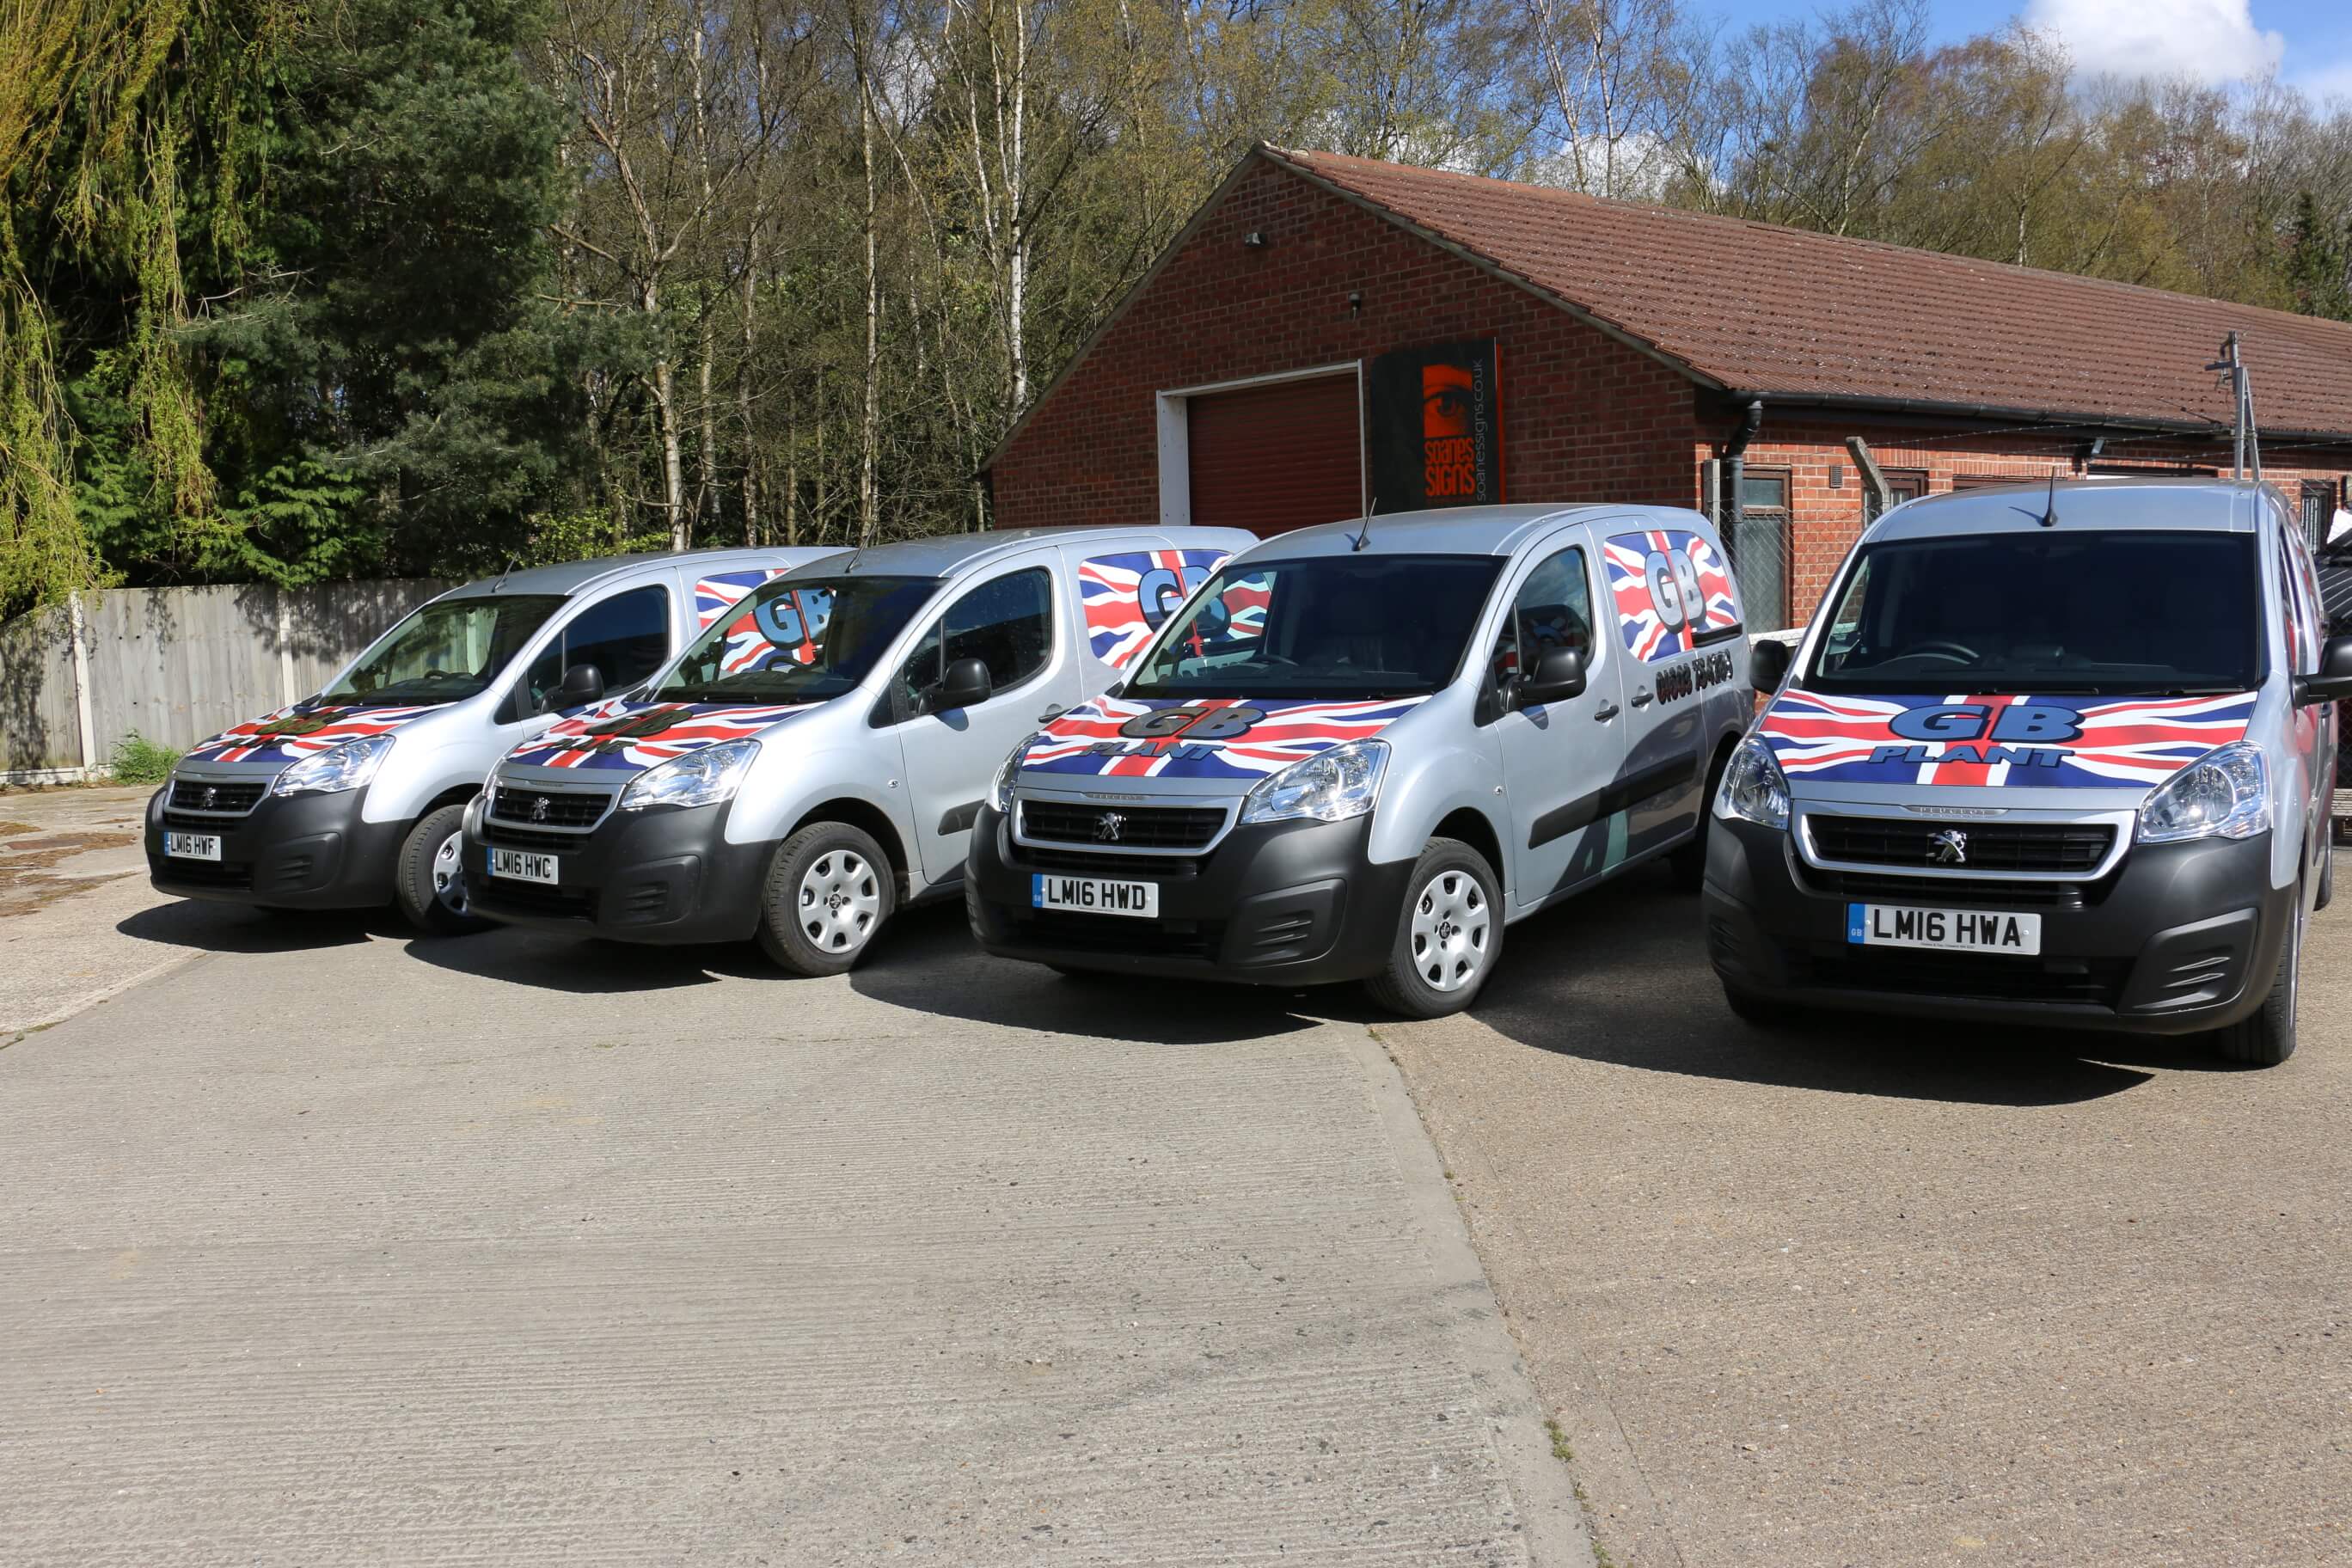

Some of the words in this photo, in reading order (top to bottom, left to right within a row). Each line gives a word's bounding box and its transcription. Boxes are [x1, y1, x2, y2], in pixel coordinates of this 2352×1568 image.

[1645, 548, 1707, 634] GB
[1118, 707, 1267, 740] GB
[1888, 704, 2086, 744] GB
[1078, 742, 1227, 761] PLANT
[1867, 745, 2075, 769] PLANT
[170, 834, 192, 854] LM16
[194, 836, 214, 855] HWF
[495, 850, 522, 874] LM16
[525, 854, 551, 879] HWC
[1048, 879, 1094, 906] LM16
[1101, 882, 1146, 910] HWD
[1851, 928, 1863, 937] GB
[1873, 909, 1946, 942] LM16
[1956, 913, 2022, 946] HWA
